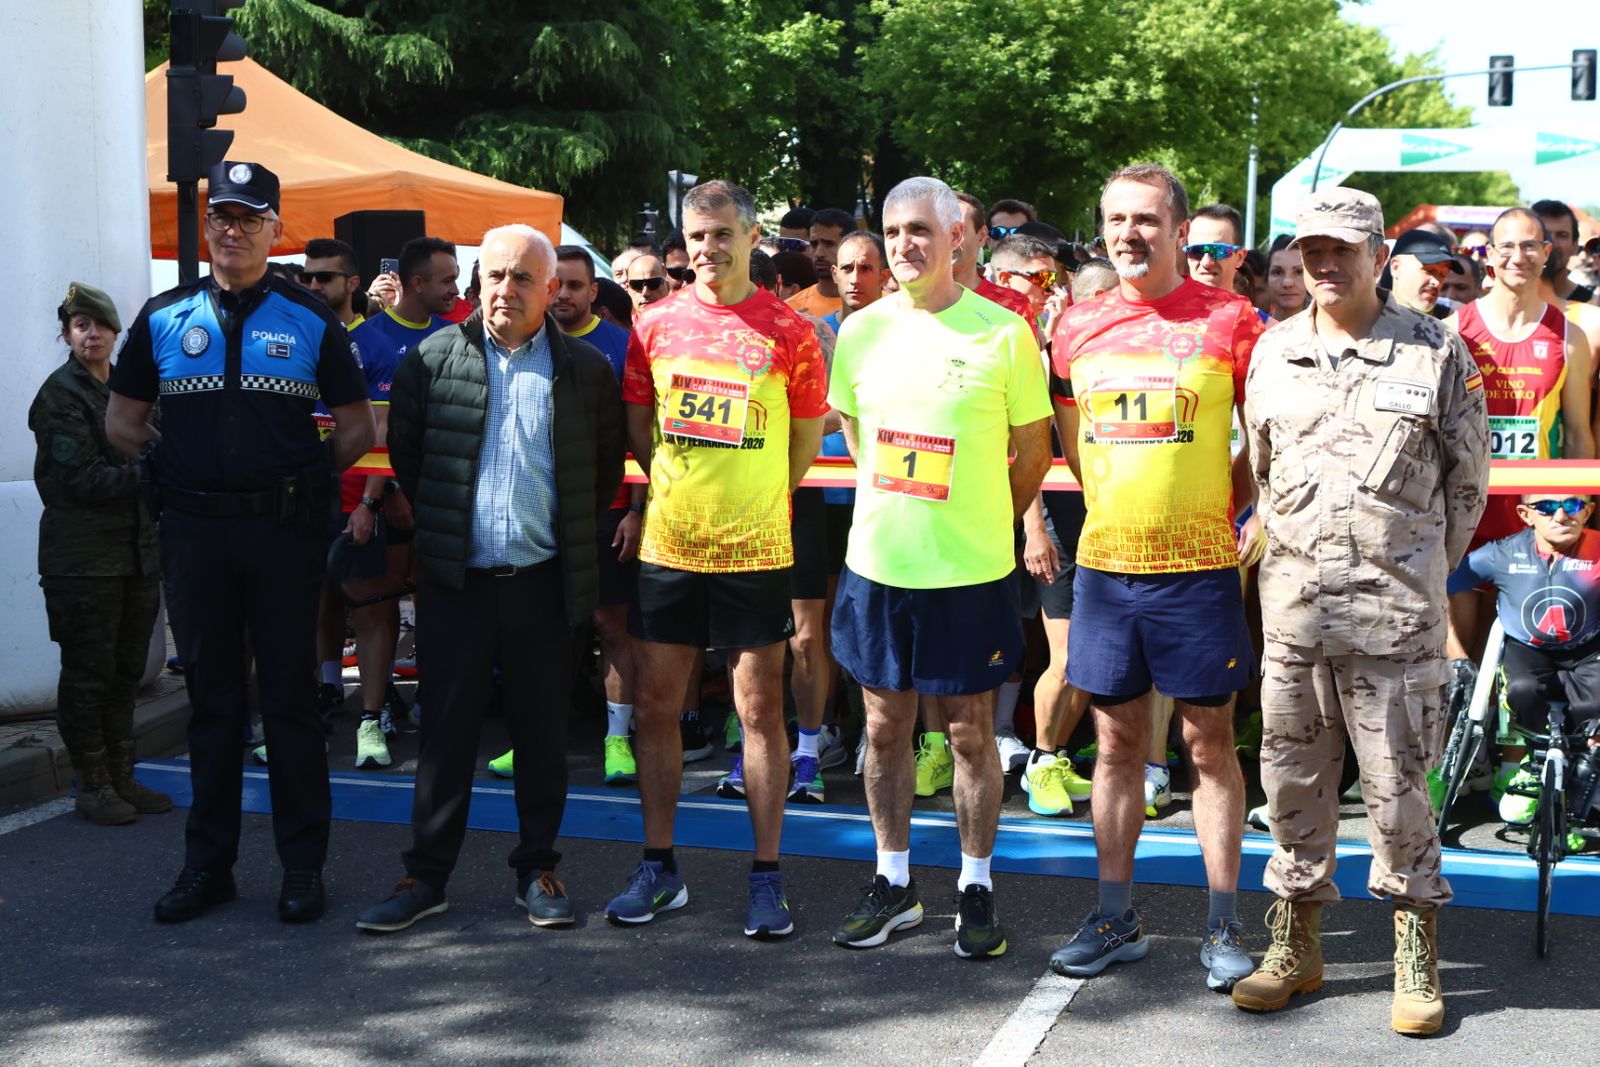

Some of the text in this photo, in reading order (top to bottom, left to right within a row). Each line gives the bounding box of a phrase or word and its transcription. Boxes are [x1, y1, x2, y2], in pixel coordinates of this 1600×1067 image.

[252, 330, 296, 344] POLICÍA
[672, 375, 692, 388] XIV
[1496, 380, 1525, 390] VINO
[692, 384, 728, 395] CARRERA
[1486, 390, 1536, 400] DE TORO
[678, 392, 732, 424] 541
[1114, 393, 1147, 420] 11
[1390, 402, 1412, 410] GALLO
[877, 428, 894, 443] XIV
[740, 438, 764, 450] 2026
[895, 439, 932, 450] CARRERA
[902, 451, 917, 478] 1
